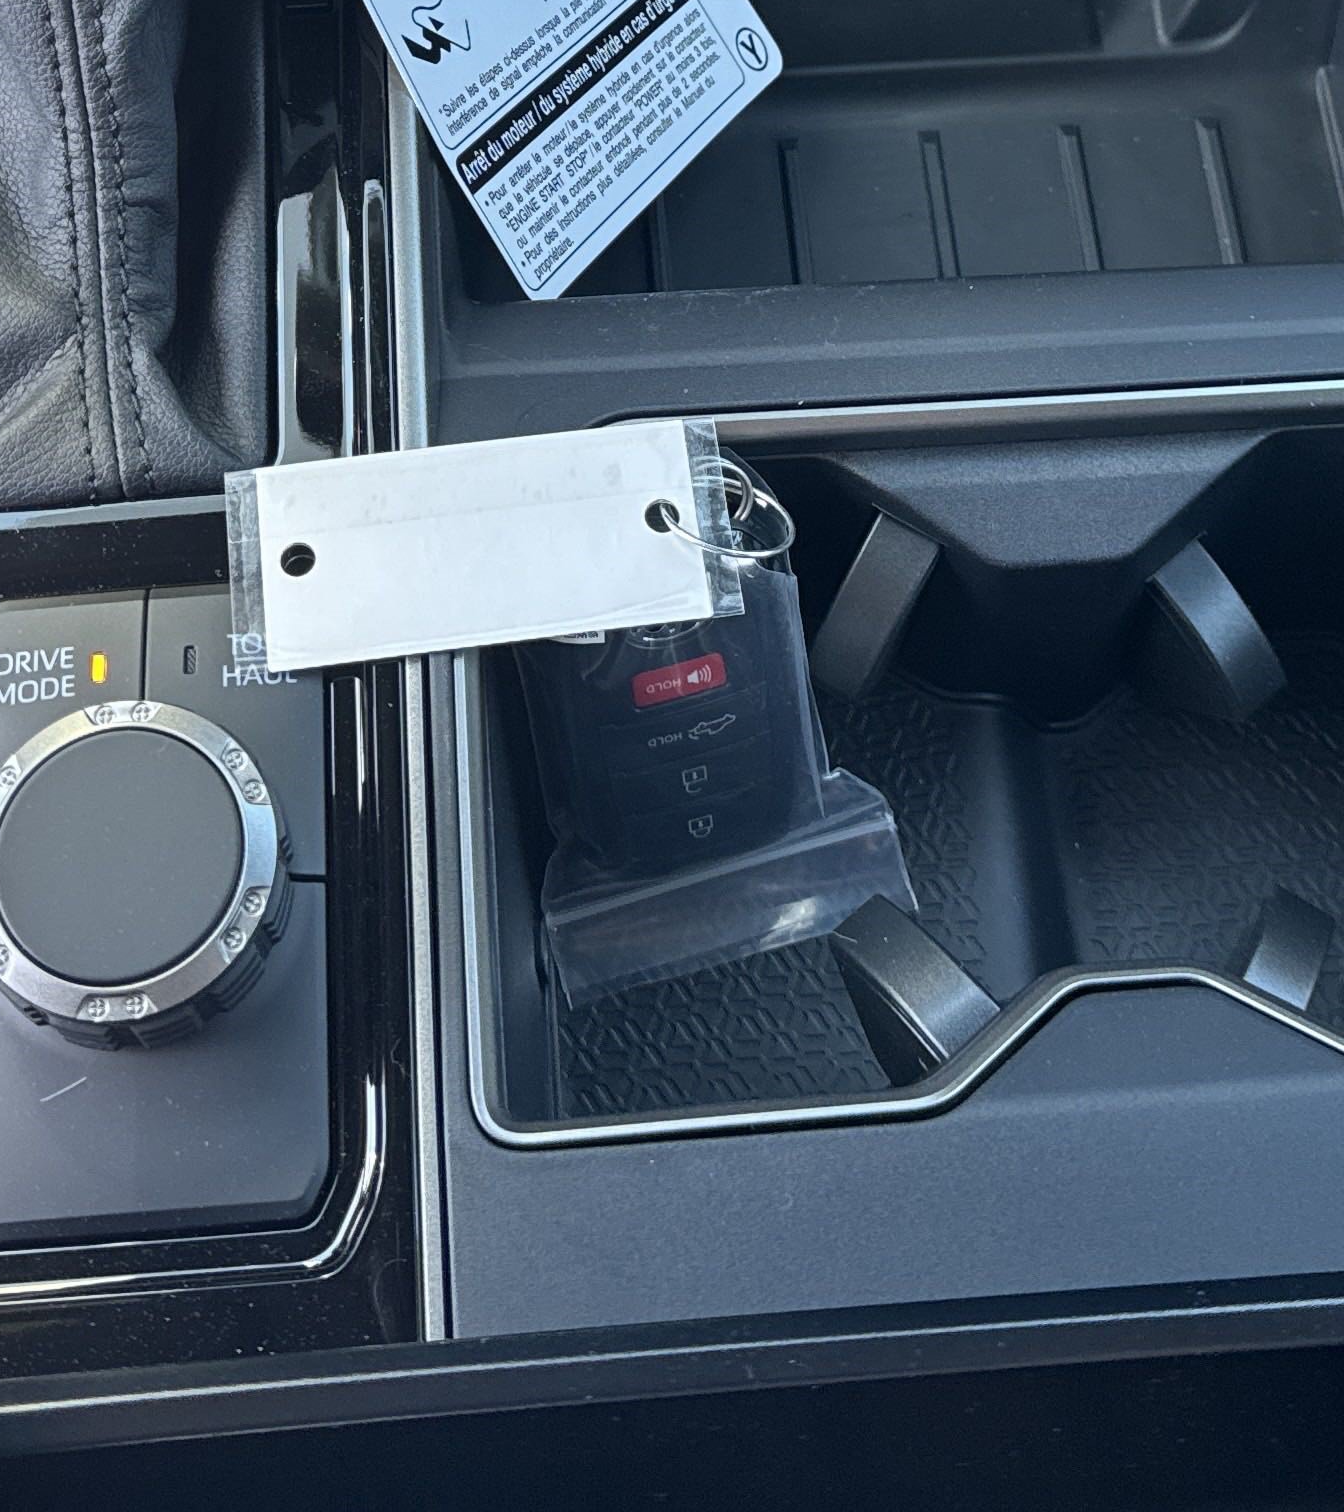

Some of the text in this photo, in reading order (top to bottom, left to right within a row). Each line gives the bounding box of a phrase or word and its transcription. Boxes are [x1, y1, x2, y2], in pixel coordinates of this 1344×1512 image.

[740, 33, 762, 65] Y
[461, 149, 491, 183] Arrêt
[501, 110, 536, 148] moteur
[552, 63, 591, 103] système
[586, 34, 622, 71] hybride
[630, 12, 649, 33] cas
[538, 172, 563, 202] START
[523, 242, 542, 263] Pour
[226, 633, 266, 656] TO
[646, 678, 682, 694] HOLD
[648, 732, 683, 747] HOLD
